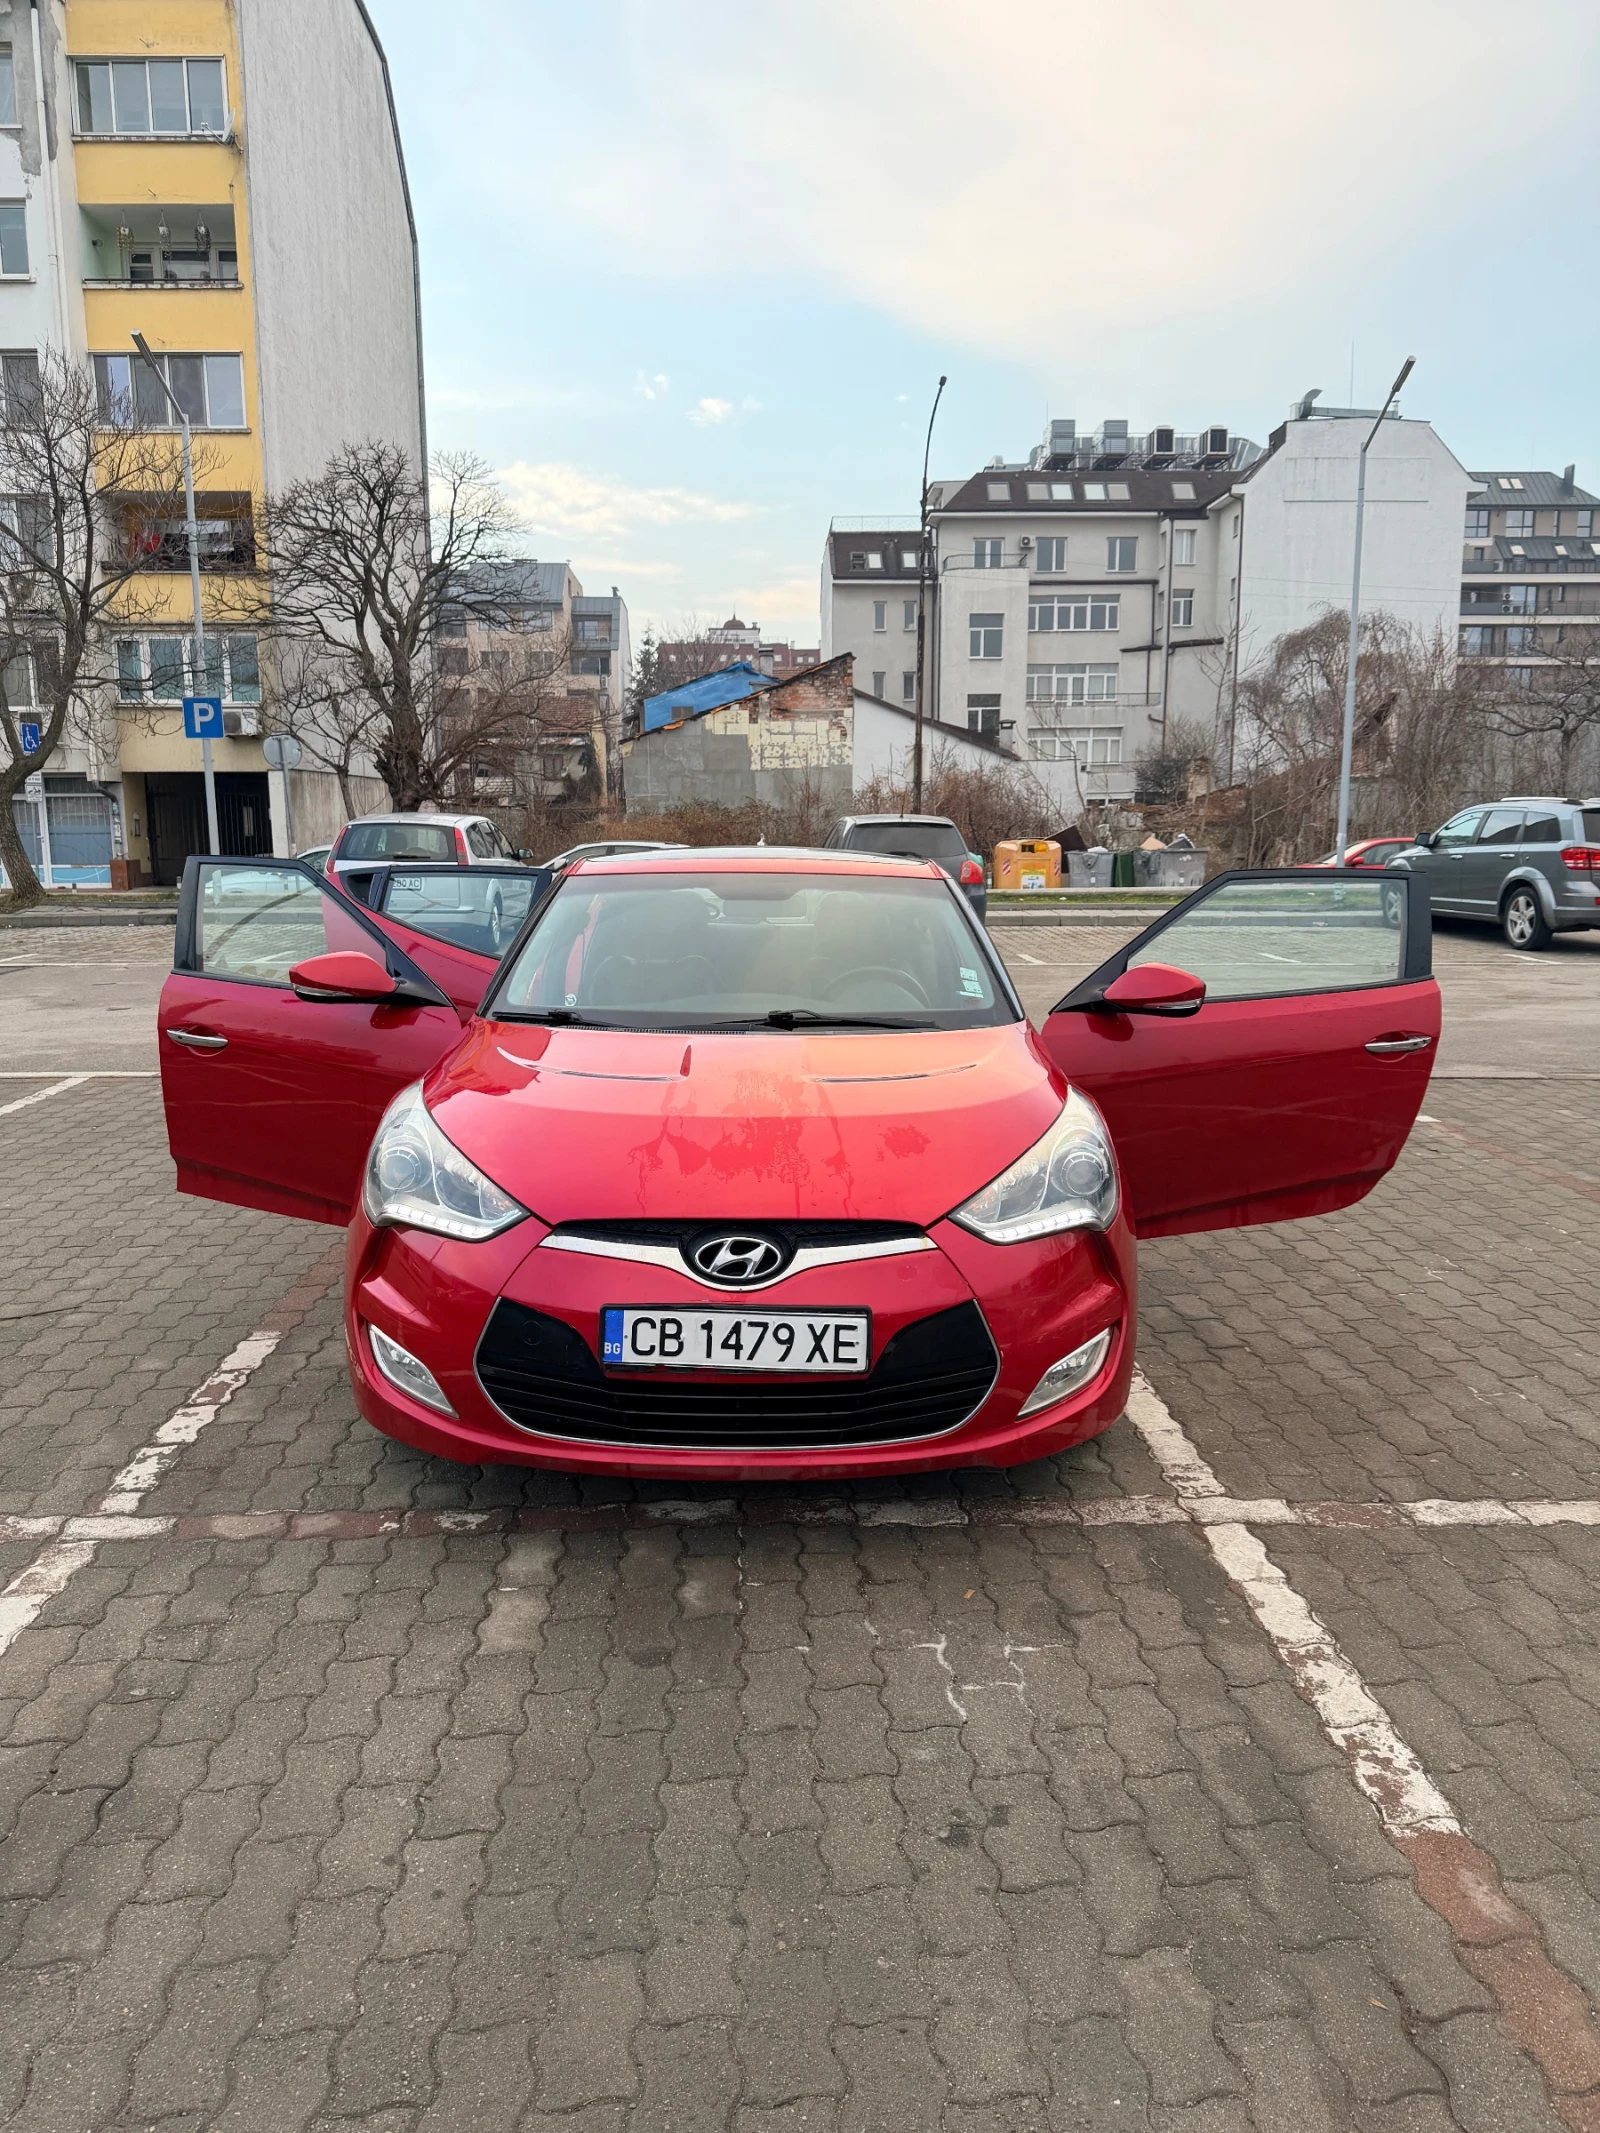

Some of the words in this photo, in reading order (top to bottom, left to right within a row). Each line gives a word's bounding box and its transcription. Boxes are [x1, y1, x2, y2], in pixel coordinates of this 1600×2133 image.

[193, 702, 215, 733] P
[408, 879, 420, 888] AC
[604, 1342, 621, 1355] BG
[631, 1317, 684, 1357] CB
[700, 1319, 796, 1363] 1479
[805, 1323, 859, 1364] XE
